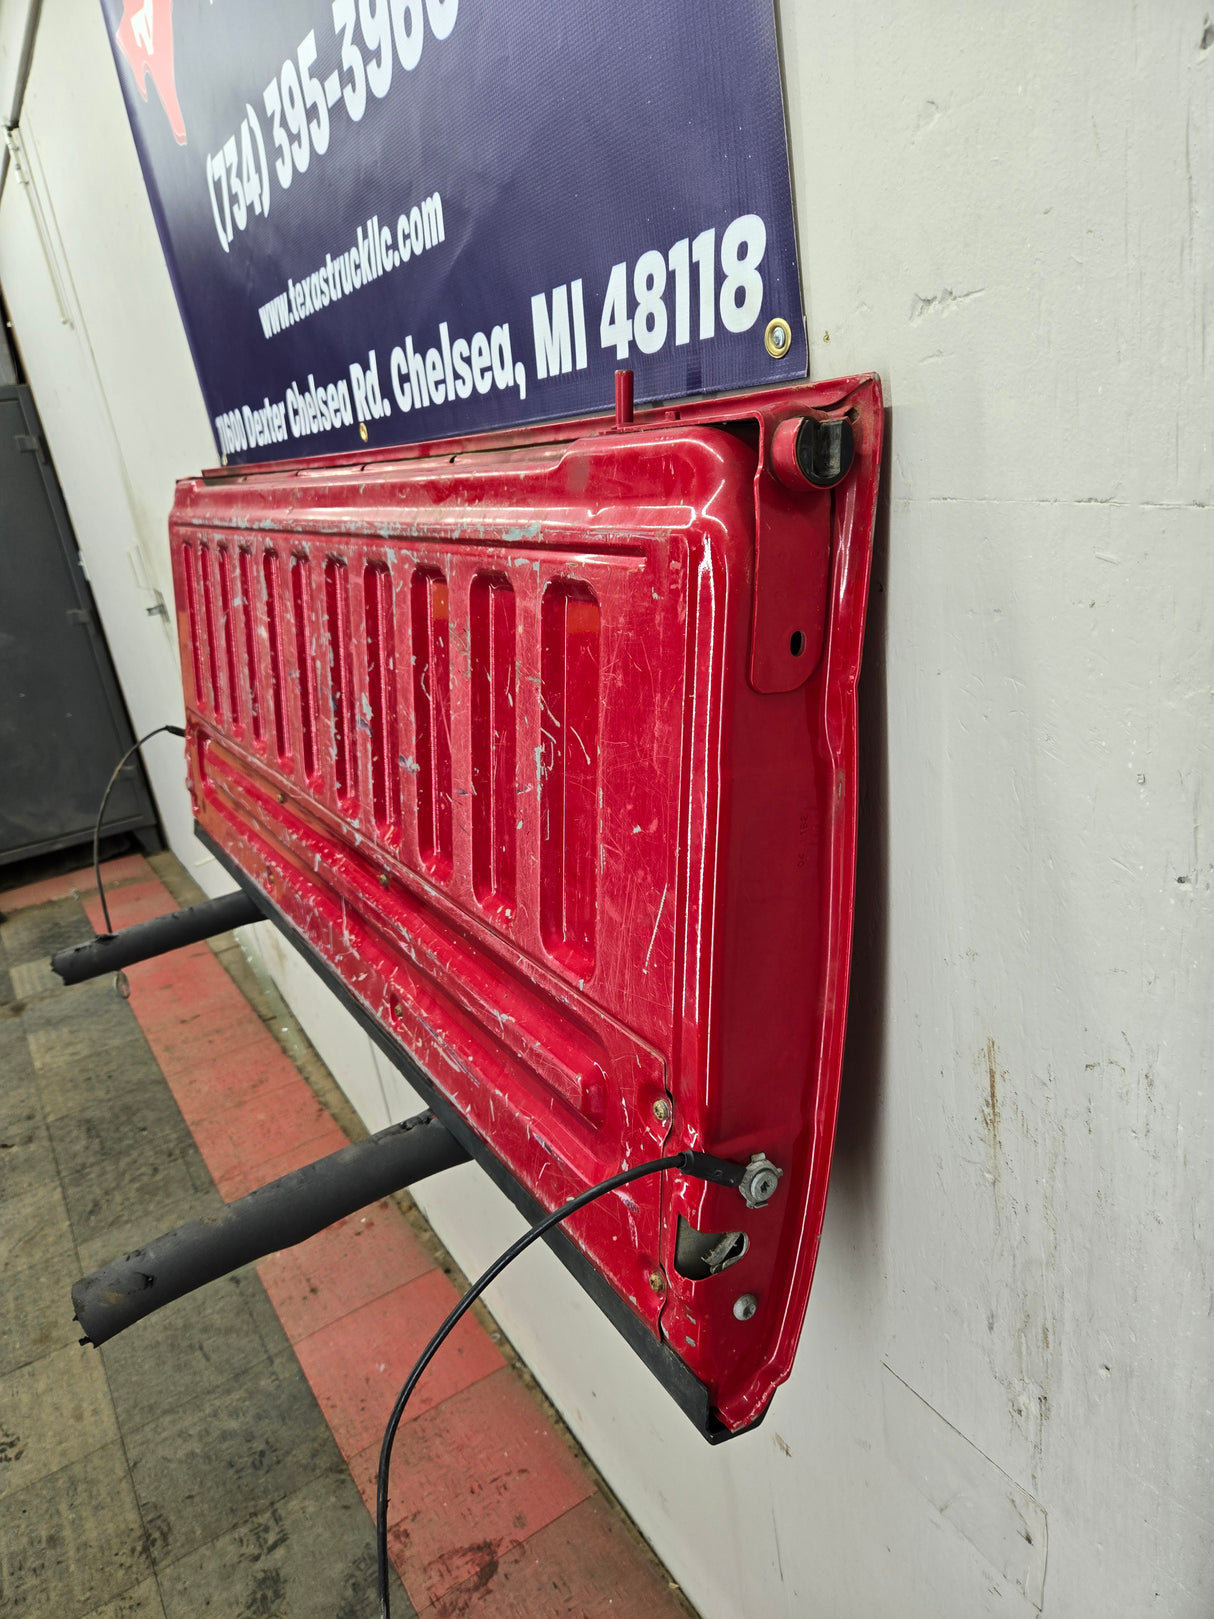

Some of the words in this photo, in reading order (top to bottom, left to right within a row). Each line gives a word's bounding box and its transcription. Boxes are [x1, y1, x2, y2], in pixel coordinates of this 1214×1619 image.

[205, 103, 271, 253] (734)
[263, 0, 459, 189] 395-396
[241, 397, 288, 449] Dexter
[285, 374, 354, 438] Chelsea
[349, 350, 391, 422] Rd.
[390, 321, 526, 413] Chelsea,
[531, 278, 588, 380] MI
[600, 214, 767, 360] 48118
[258, 191, 446, 339] www.texastruckllc.com
